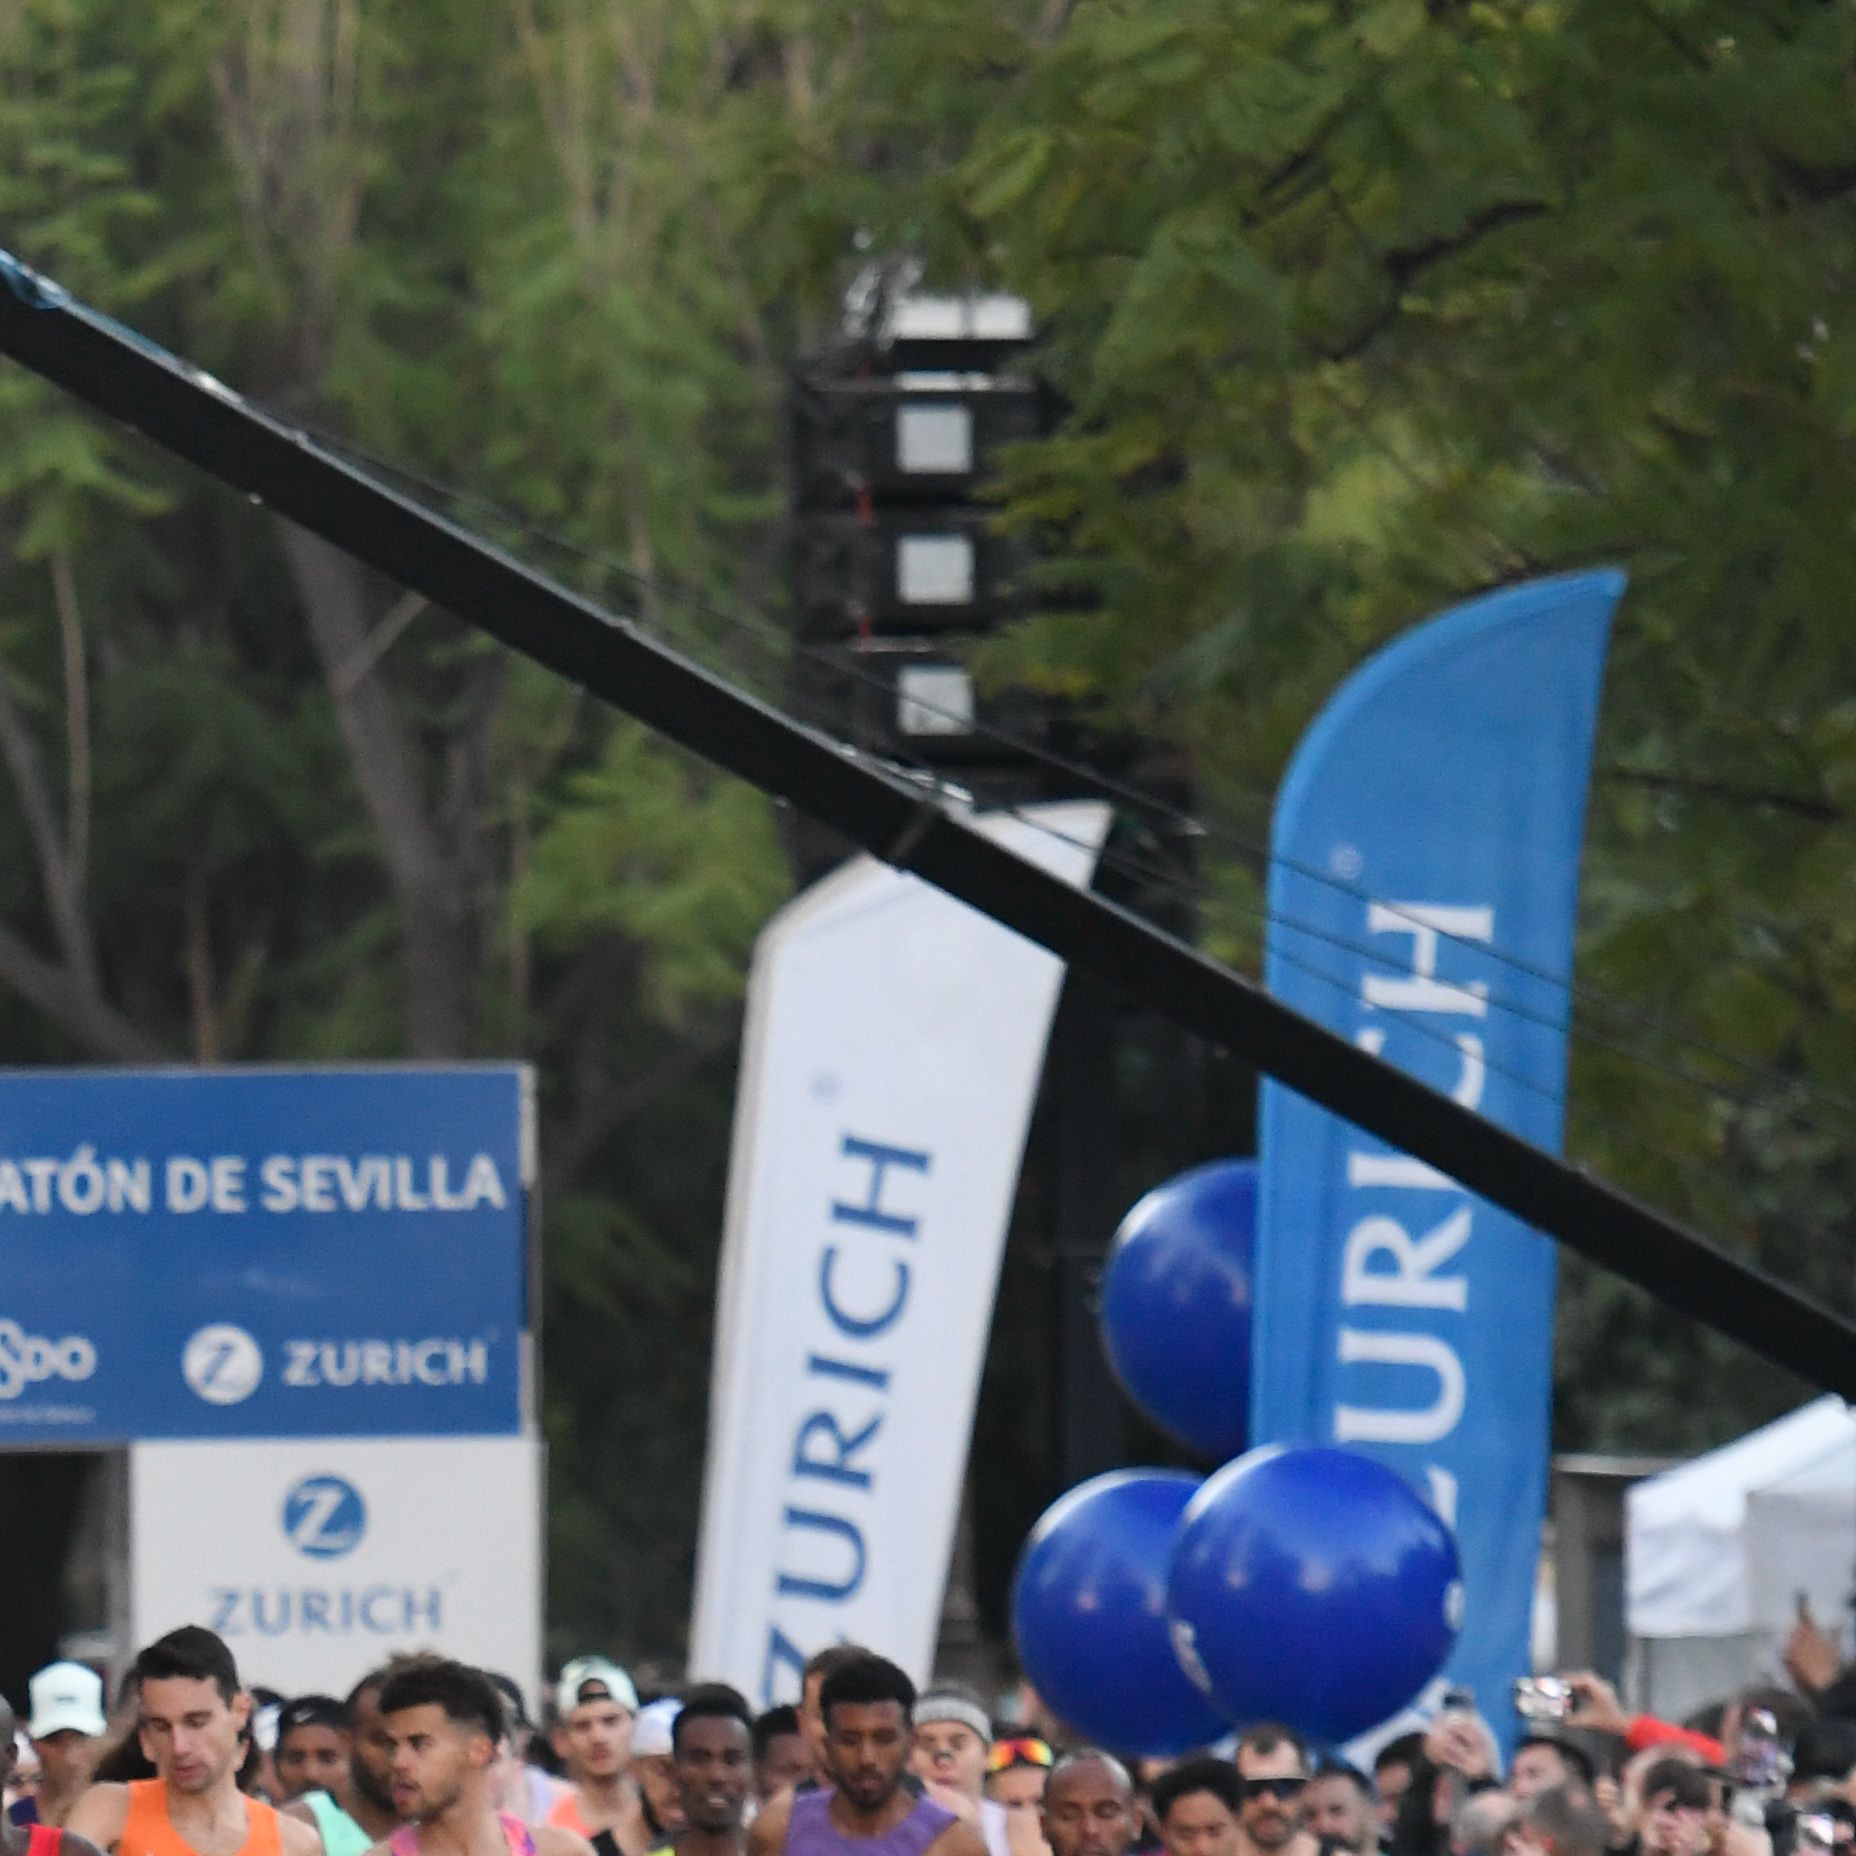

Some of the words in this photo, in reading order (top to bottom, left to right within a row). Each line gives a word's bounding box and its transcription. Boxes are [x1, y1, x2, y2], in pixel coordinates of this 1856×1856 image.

[165, 1156, 247, 1213] DE
[260, 1154, 507, 1212] SEVILLA
[1334, 898, 1494, 1528] URIH
[282, 1338, 488, 1387] ZURICH
[211, 1586, 443, 1636] ZURICH
